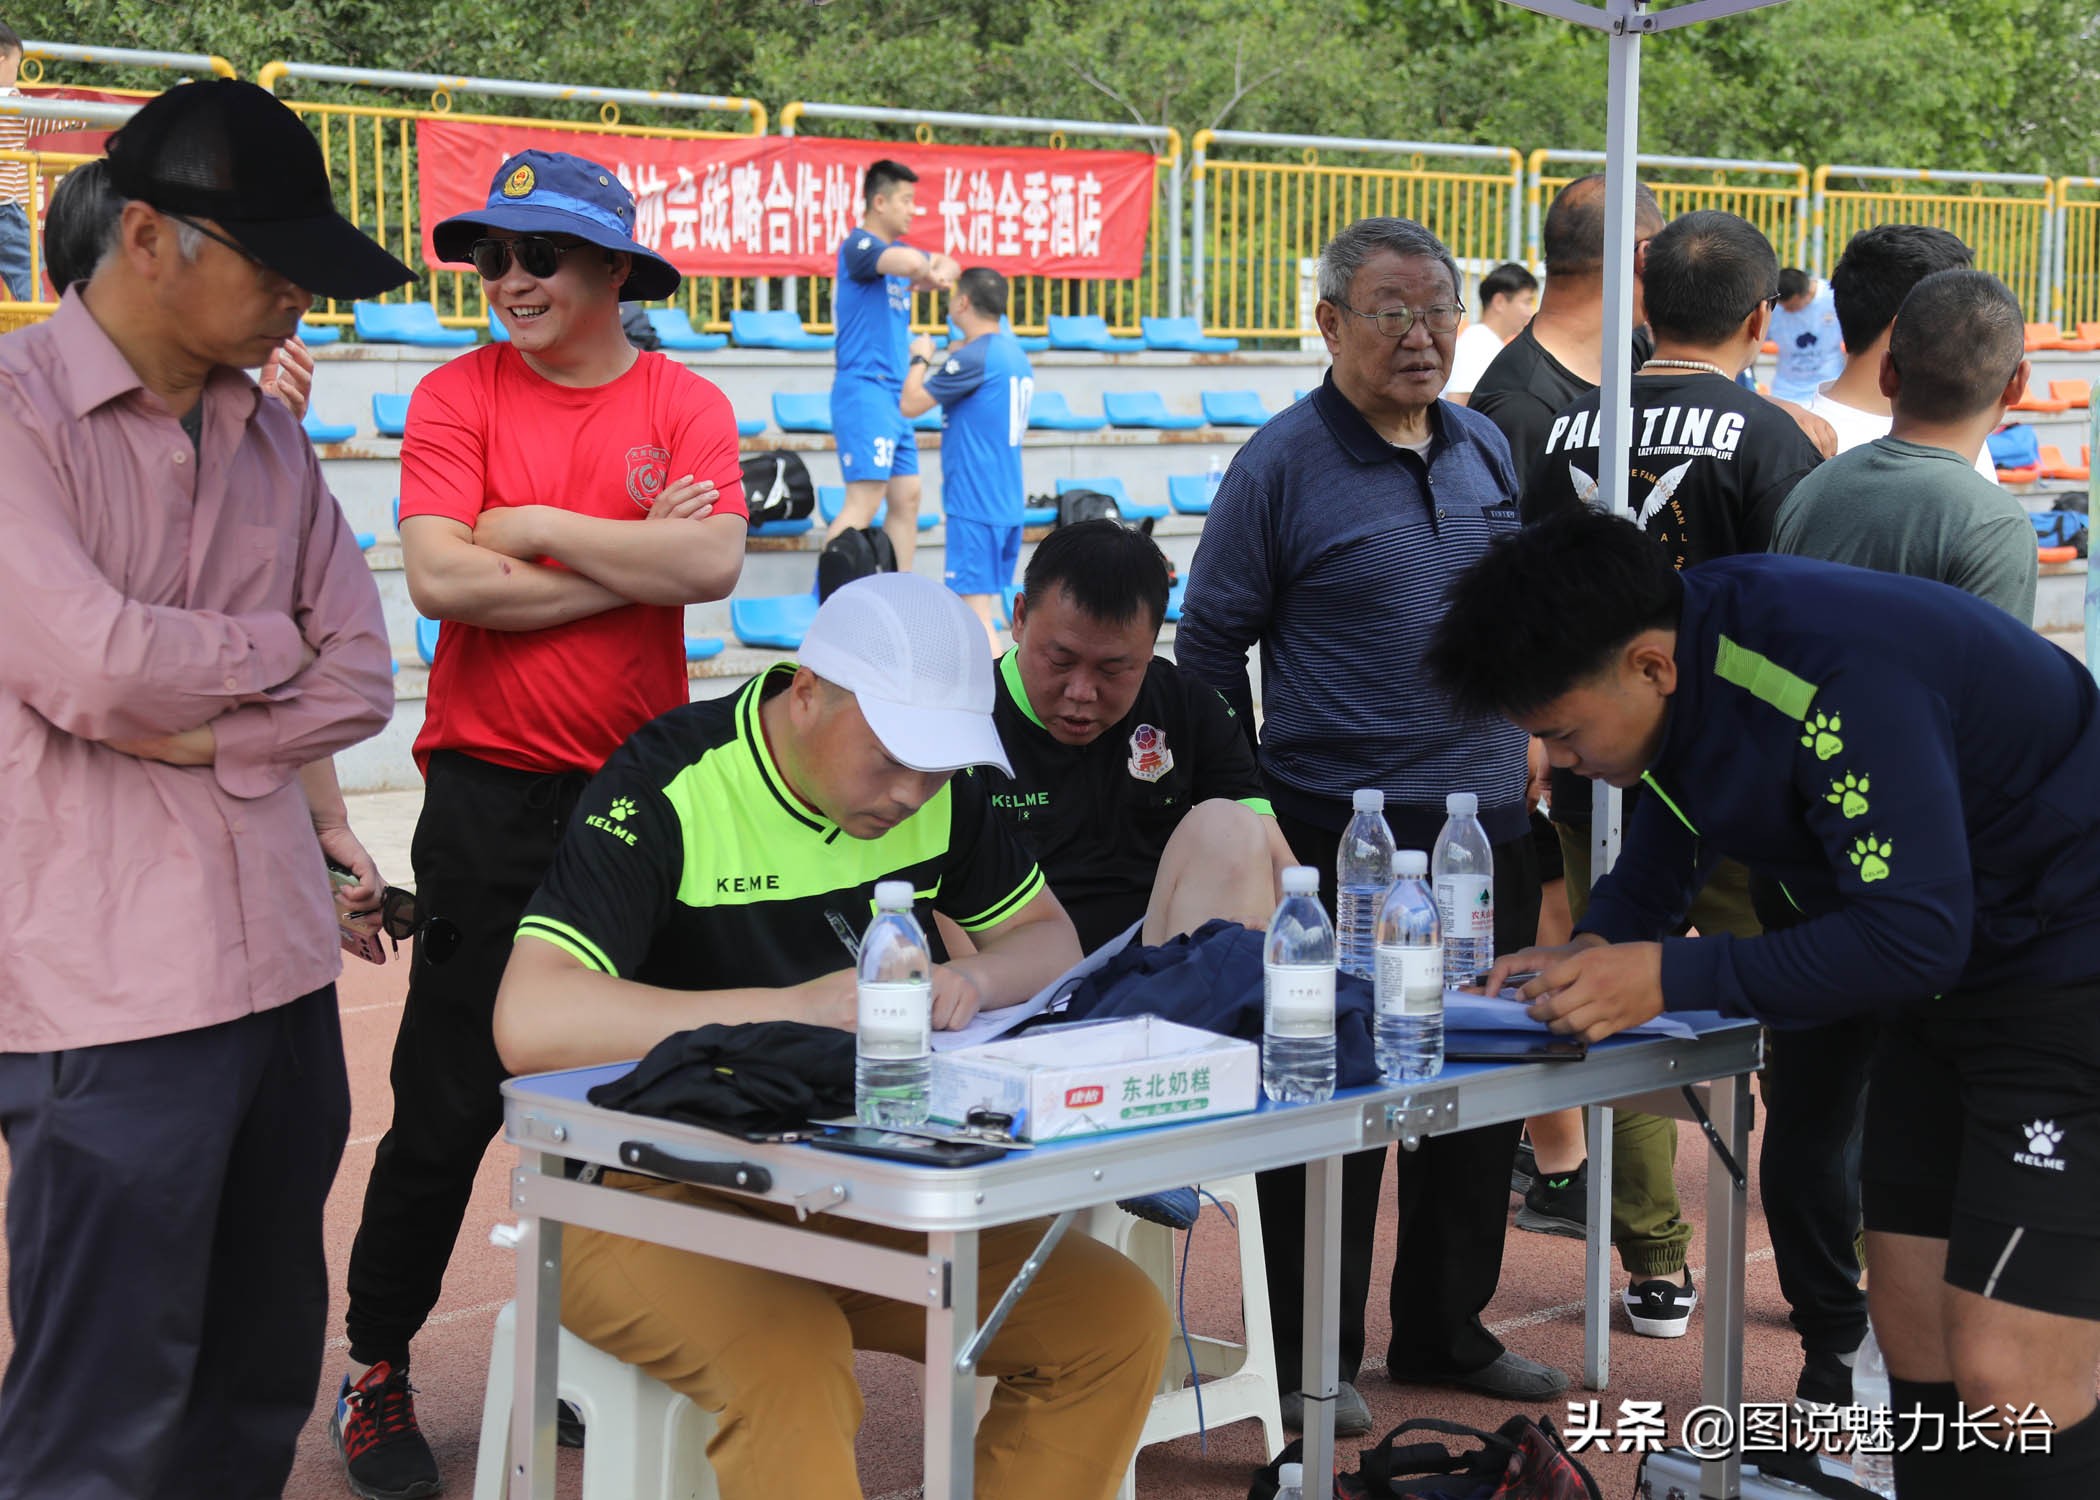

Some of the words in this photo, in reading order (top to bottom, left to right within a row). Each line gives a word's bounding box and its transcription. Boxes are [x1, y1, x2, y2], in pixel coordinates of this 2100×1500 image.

[938, 167, 1102, 258] 长治全季酒店
[1638, 447, 1653, 456] LAZY
[1653, 446, 1683, 455] ATTITUDE
[1717, 451, 1733, 461] LIFE
[991, 791, 1050, 808] KELME
[585, 814, 639, 847] KELME
[716, 875, 780, 893] KEME
[1122, 1066, 1211, 1102] 东北奶糕
[2013, 1152, 2065, 1171] KELME
